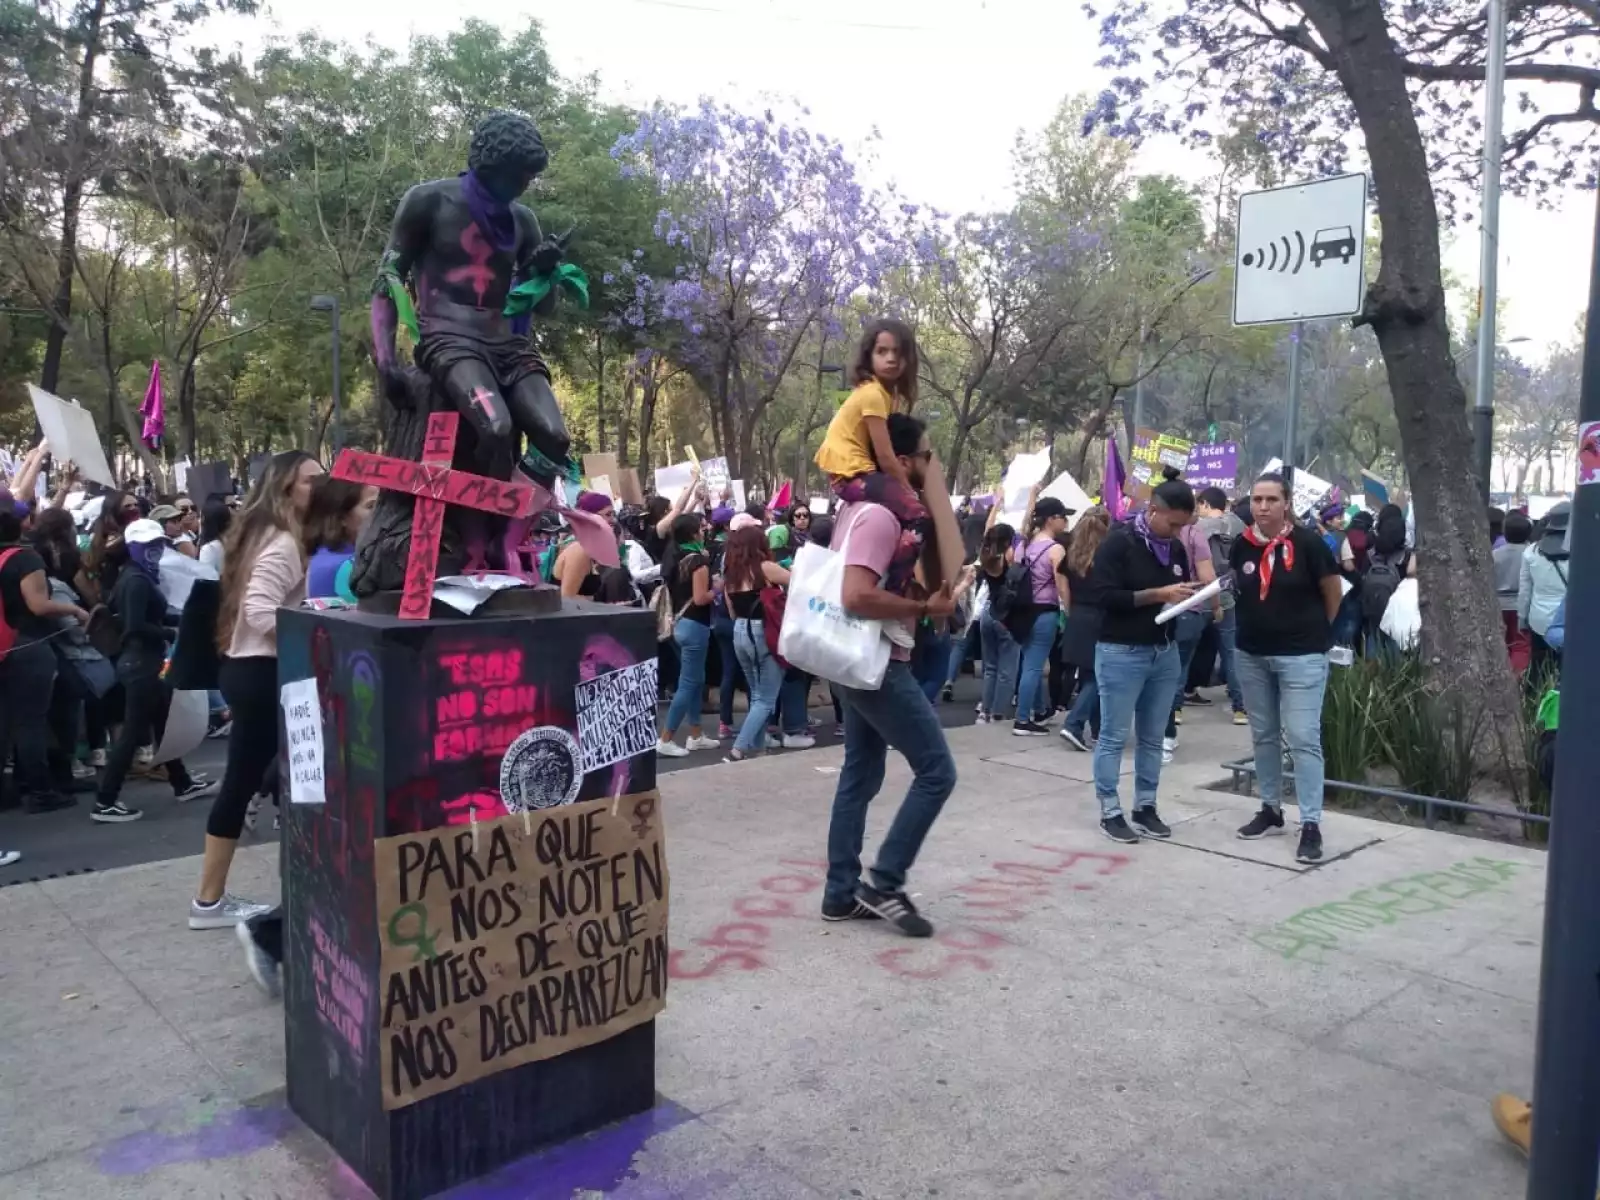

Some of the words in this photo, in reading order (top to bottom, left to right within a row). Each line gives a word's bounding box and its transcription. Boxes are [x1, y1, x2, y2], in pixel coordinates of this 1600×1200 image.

[345, 458, 390, 478] NI
[400, 467, 450, 493] UNA
[457, 479, 523, 514] MAS
[437, 690, 476, 723] NO
[482, 685, 537, 717] SON
[397, 824, 517, 904] PARA
[535, 808, 608, 868] QUE
[450, 881, 522, 943] NOS
[539, 841, 664, 924] NOTEN
[382, 946, 488, 1028] ANTES
[515, 921, 565, 979] DE
[577, 907, 648, 959] QUE
[390, 1016, 459, 1097] NOS
[479, 926, 668, 1062] DESAPAREZCAN
